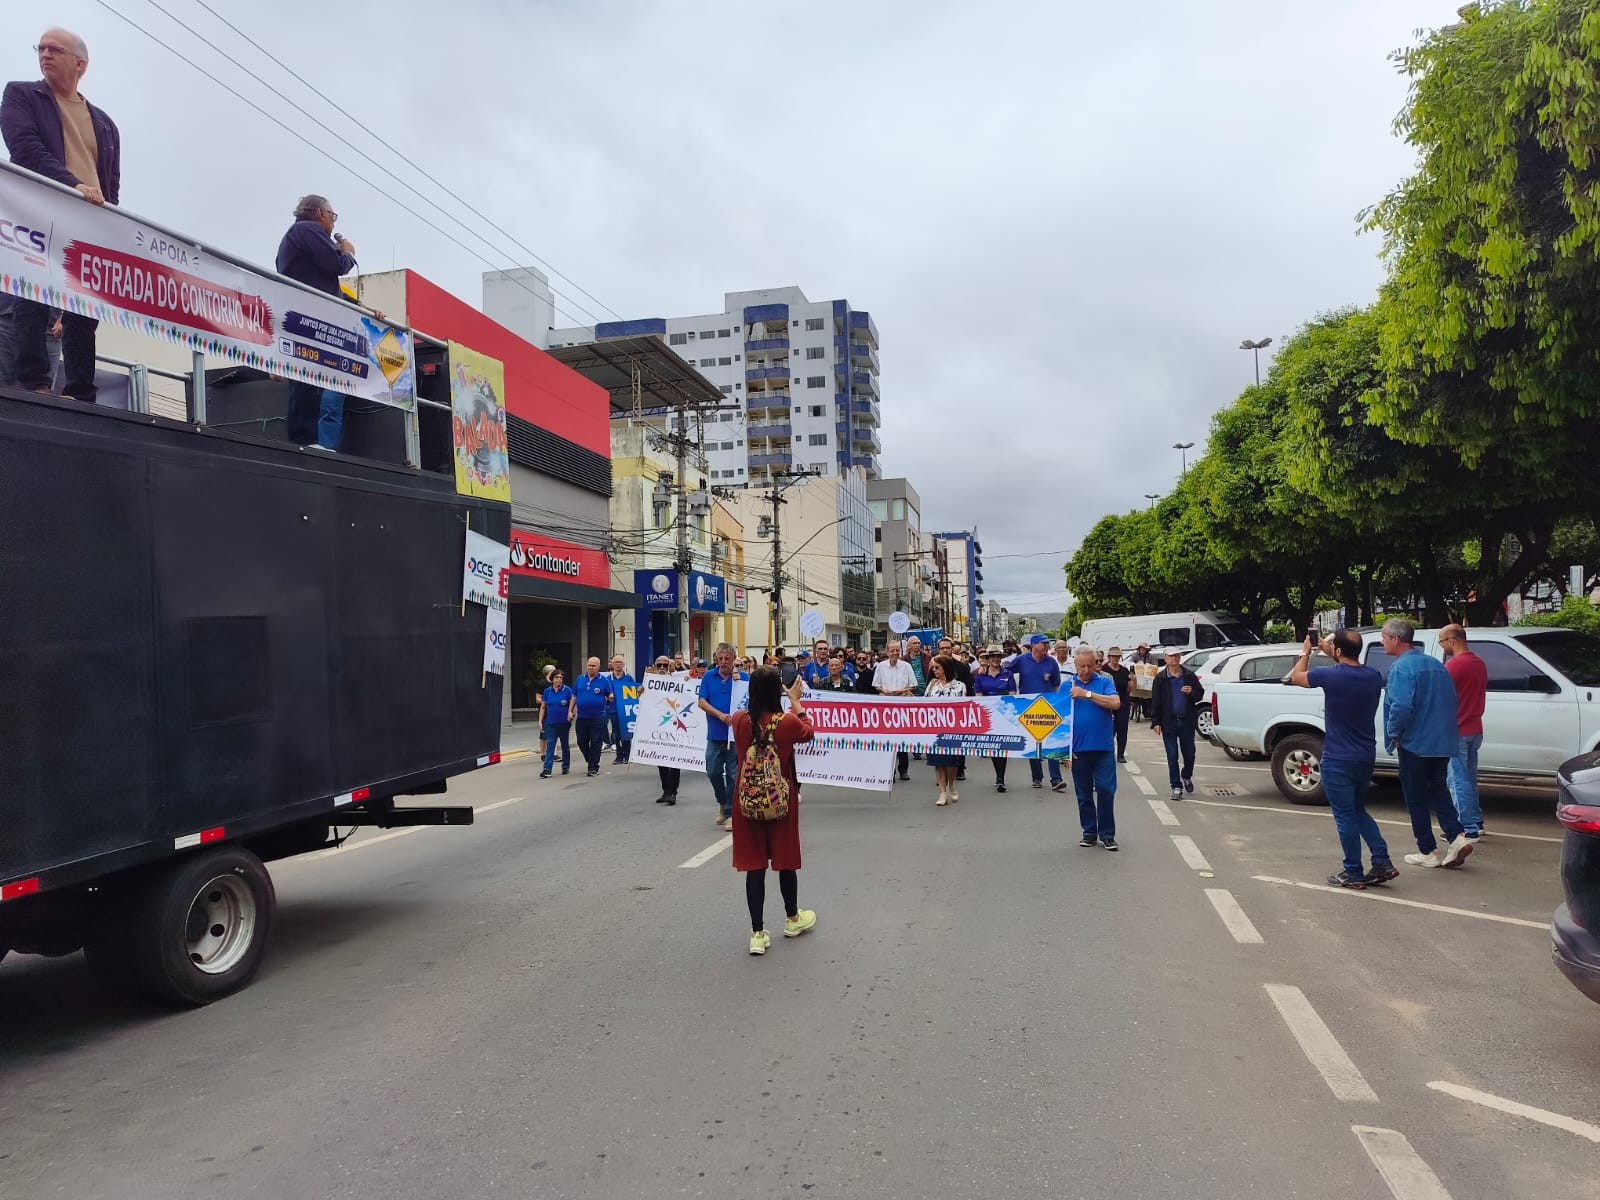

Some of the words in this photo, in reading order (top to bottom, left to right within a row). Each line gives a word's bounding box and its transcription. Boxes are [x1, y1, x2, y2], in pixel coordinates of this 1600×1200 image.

[0, 219, 46, 254] CCS
[150, 237, 188, 267] APOIA
[80, 253, 154, 305] ESTRADA
[157, 274, 178, 311] DO
[181, 281, 244, 328] CONTORNO
[246, 296, 265, 334] JÁ!
[299, 317, 319, 330] JUNTOS
[319, 321, 329, 333] POR
[453, 411, 508, 456] BALADA
[476, 561, 494, 578] CCS
[527, 547, 581, 577] Santander
[646, 593, 675, 601] ITANET
[647, 679, 685, 694] CONPAI
[804, 707, 859, 728] STRADA
[861, 707, 880, 729] DO
[882, 707, 956, 729] CONTORNO
[959, 703, 983, 728] JÁ!
[963, 734, 977, 742] POR
[636, 748, 669, 761] Mulher:
[847, 775, 863, 784] um
[864, 775, 876, 784] só
